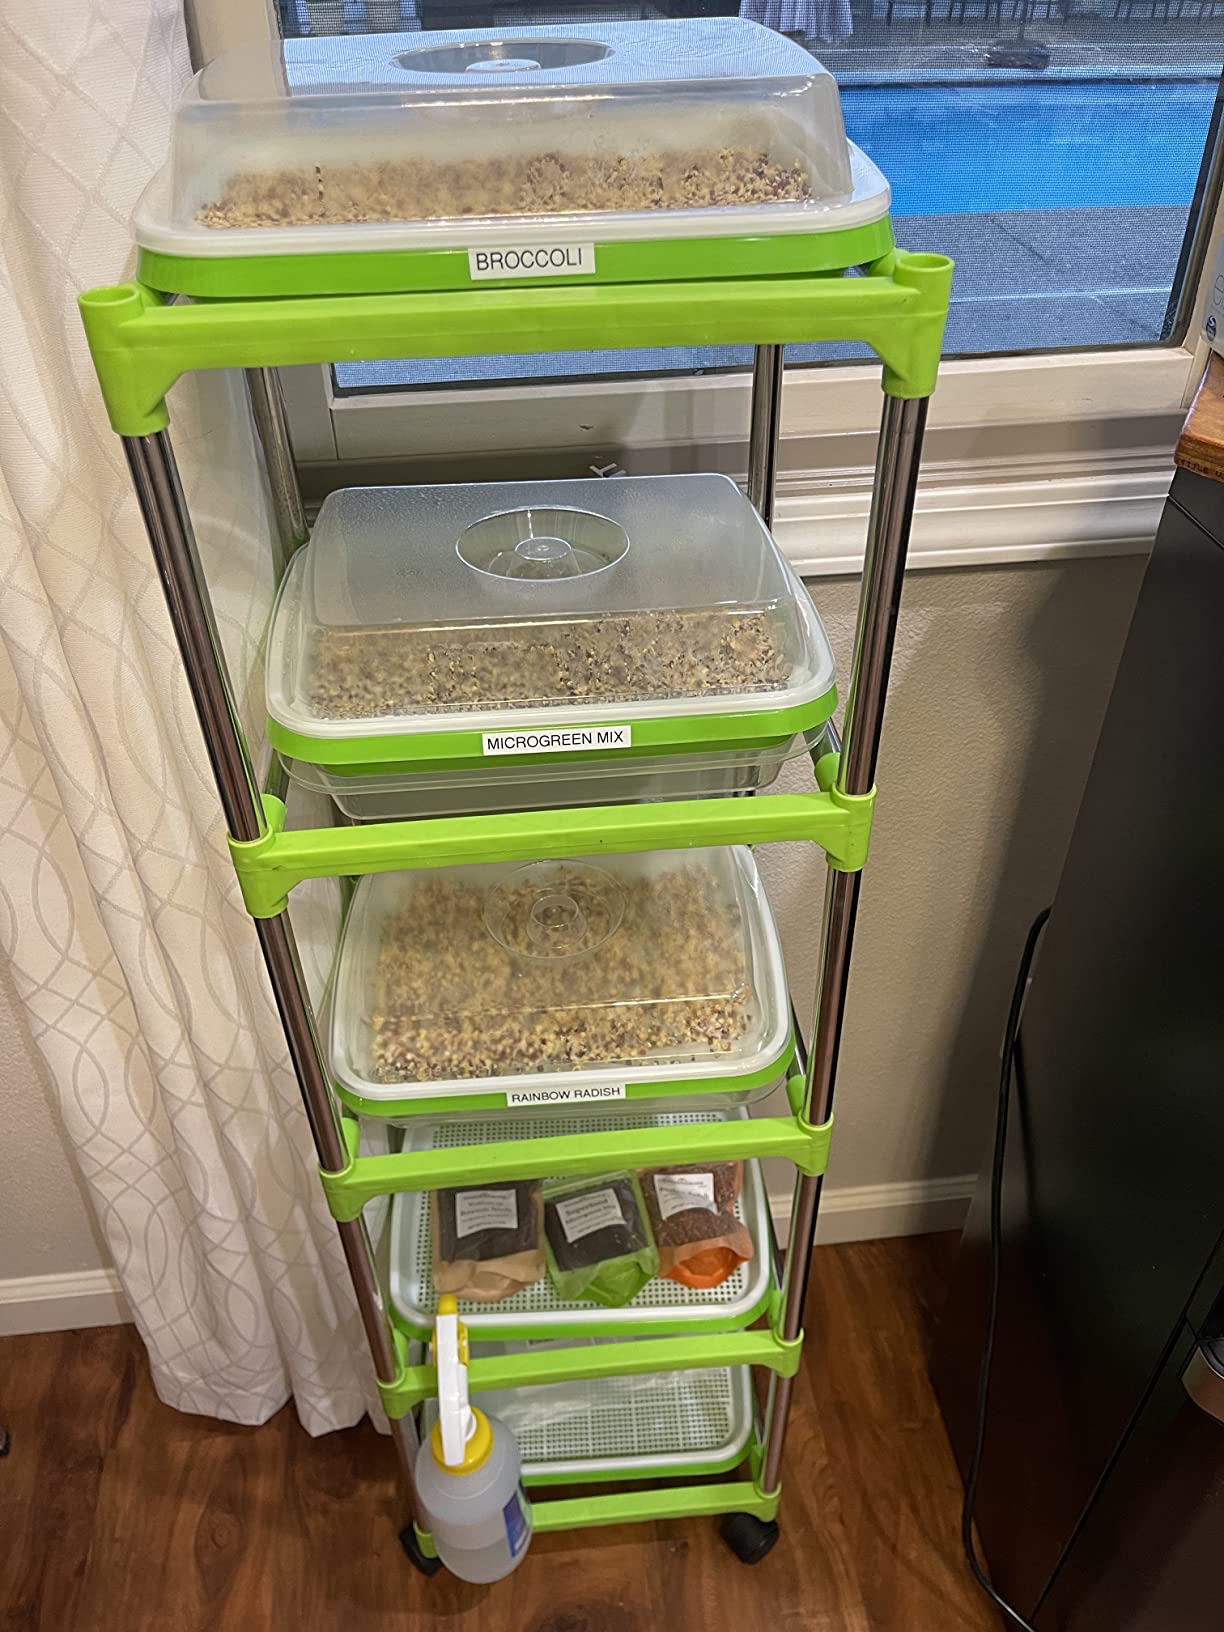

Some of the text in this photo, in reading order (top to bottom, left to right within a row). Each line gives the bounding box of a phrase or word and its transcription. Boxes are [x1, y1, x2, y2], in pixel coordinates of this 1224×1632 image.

[476, 247, 582, 271] BROCCOLI
[487, 730, 625, 750] MICROGREEN MIX
[511, 1087, 621, 1102] RAINBOW RADISH
